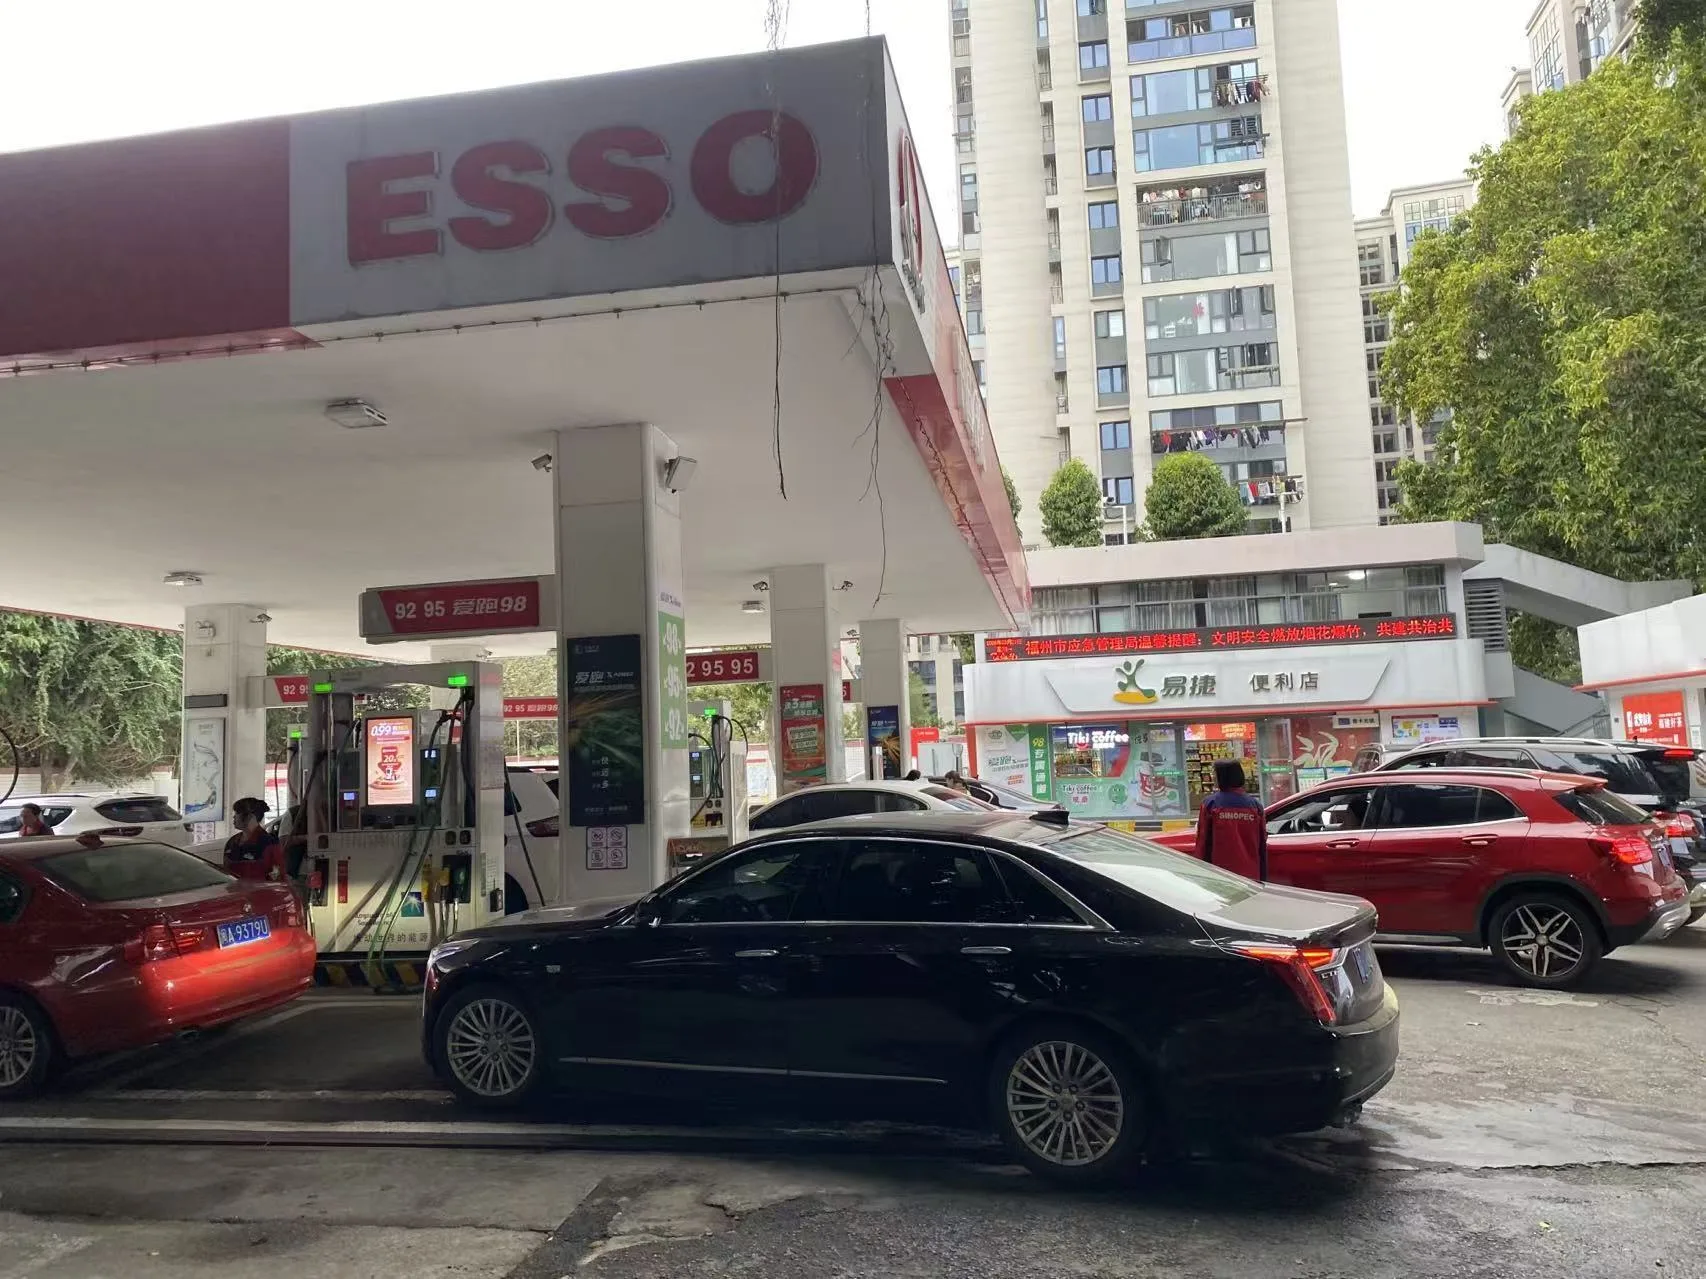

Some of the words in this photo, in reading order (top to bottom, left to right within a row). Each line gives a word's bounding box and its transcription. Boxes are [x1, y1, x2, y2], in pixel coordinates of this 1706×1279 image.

[346, 109, 820, 268] ESSO
[395, 602, 417, 619] 92
[423, 600, 446, 617] 95
[686, 661, 696, 677] 2
[701, 660, 724, 676] 95
[731, 658, 754, 675] 95
[283, 684, 296, 695] 92
[1160, 674, 1217, 697] 易捷
[1250, 671, 1319, 692] 便利店
[515, 704, 525, 712] 95
[1032, 737, 1045, 748] 98
[1067, 731, 1090, 745] Tiki
[1092, 730, 1130, 743] coffee
[1218, 811, 1255, 821] SINOPEC
